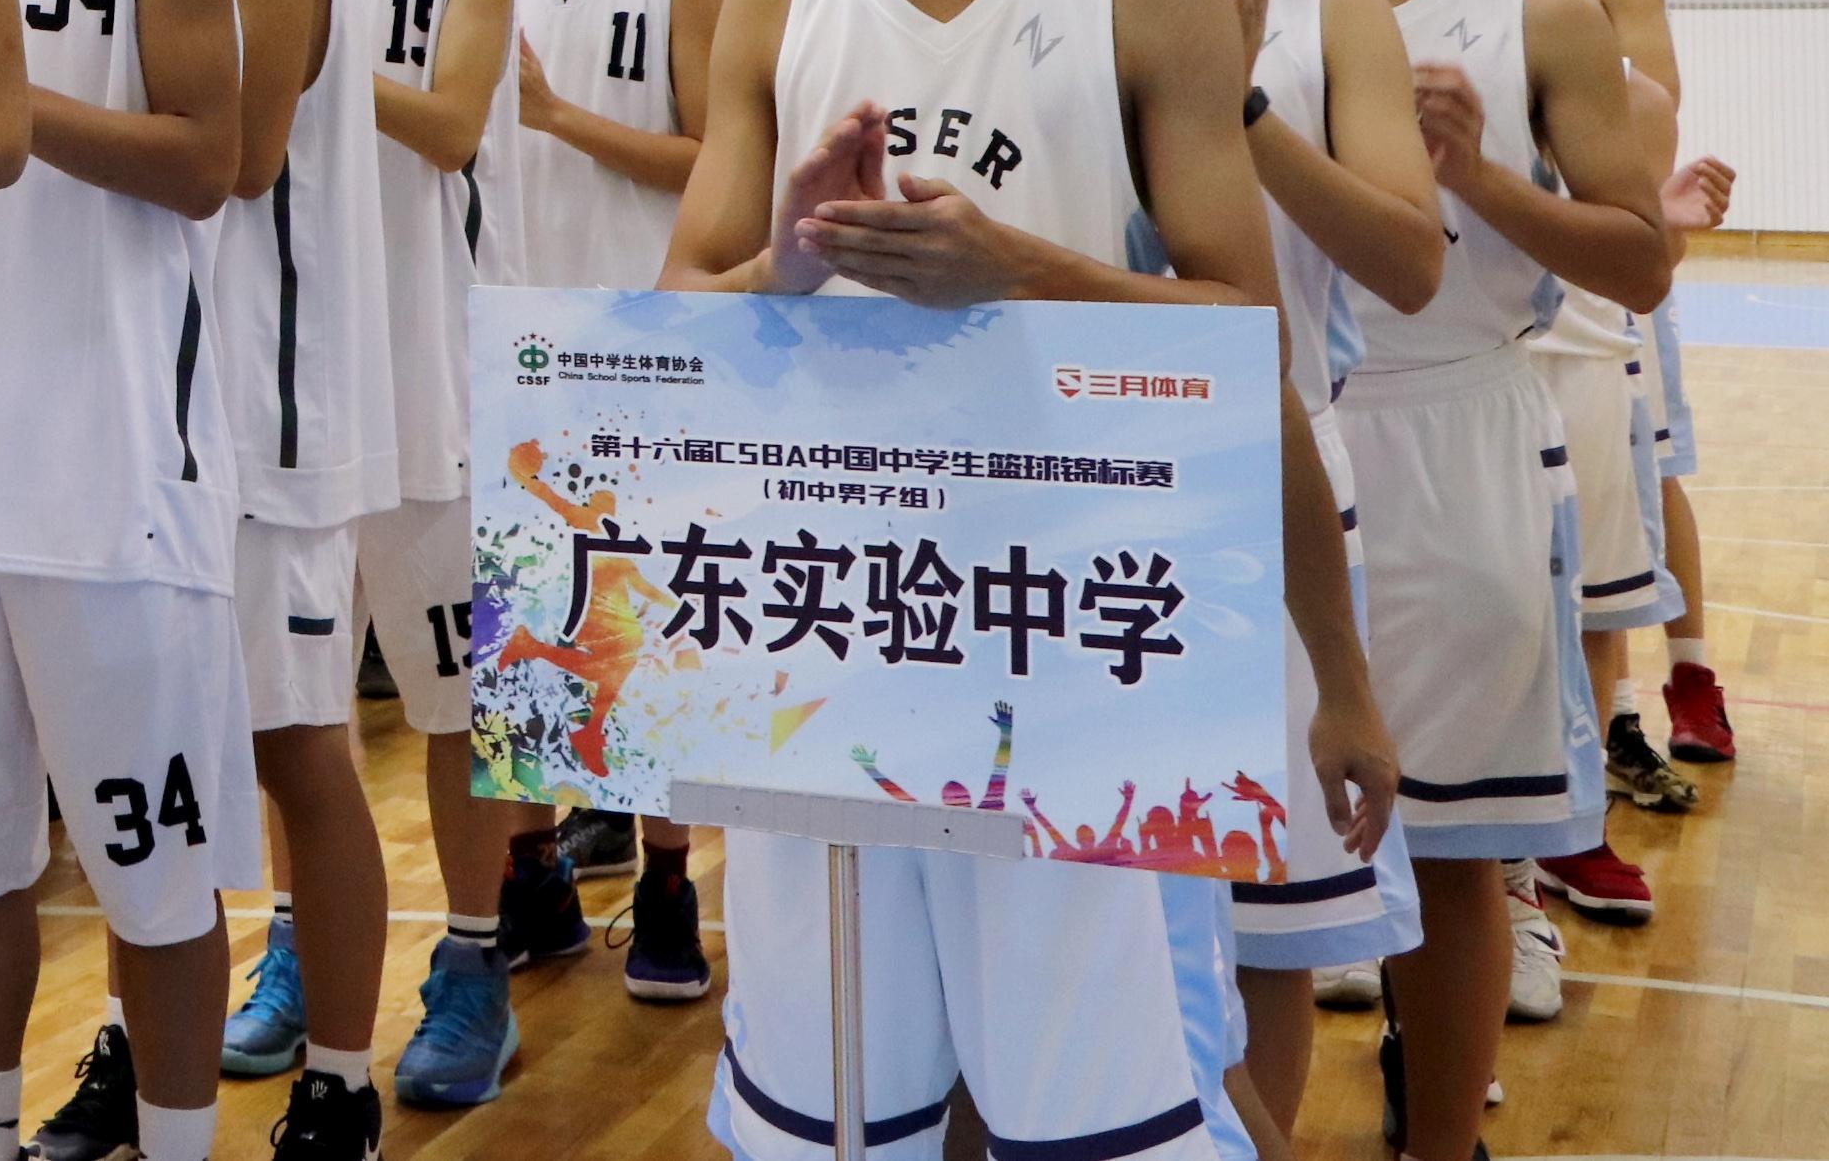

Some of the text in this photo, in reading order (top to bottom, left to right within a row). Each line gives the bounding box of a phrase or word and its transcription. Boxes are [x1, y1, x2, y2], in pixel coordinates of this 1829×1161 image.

[607, 11, 647, 82] 11
[885, 107, 1024, 190] SER
[516, 375, 551, 386] CSSF
[557, 351, 704, 373] 中国中学生体育协会
[557, 371, 705, 385] China School Sports Federation
[1088, 374, 1212, 400] 三月体育
[590, 432, 1175, 489] 第十六届CSBA中国中学生篮球锦标赛
[560, 518, 1186, 686] 广东实验中学
[94, 752, 207, 867] 34
